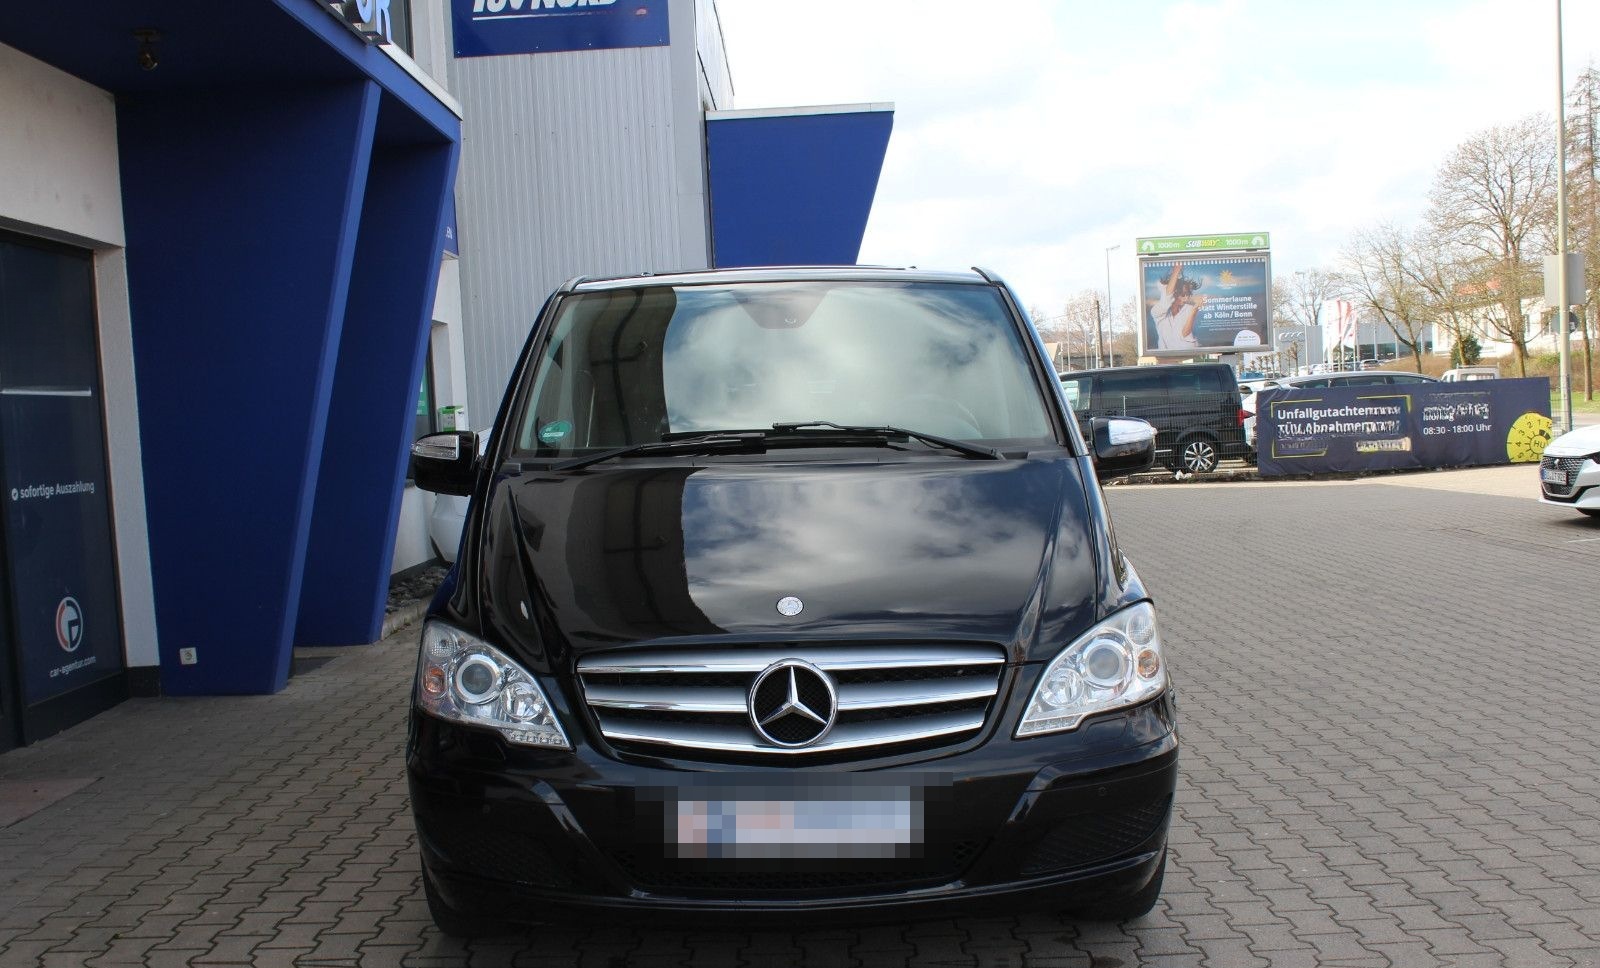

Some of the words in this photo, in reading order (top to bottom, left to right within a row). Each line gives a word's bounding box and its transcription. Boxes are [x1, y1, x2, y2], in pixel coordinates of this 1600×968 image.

[1186, 239, 1218, 248] SUBWAY
[1202, 295, 1252, 304] Sommerlaune
[1216, 302, 1258, 311] Winterstille
[1423, 426, 1446, 435] 08:30
[1452, 424, 1474, 434] 18:00
[1475, 423, 1492, 432] Uhr
[1534, 439, 1546, 448] HU
[20, 484, 54, 499] sofortige
[55, 480, 95, 494] Auszahlung
[49, 656, 96, 678] car-agentur.com
